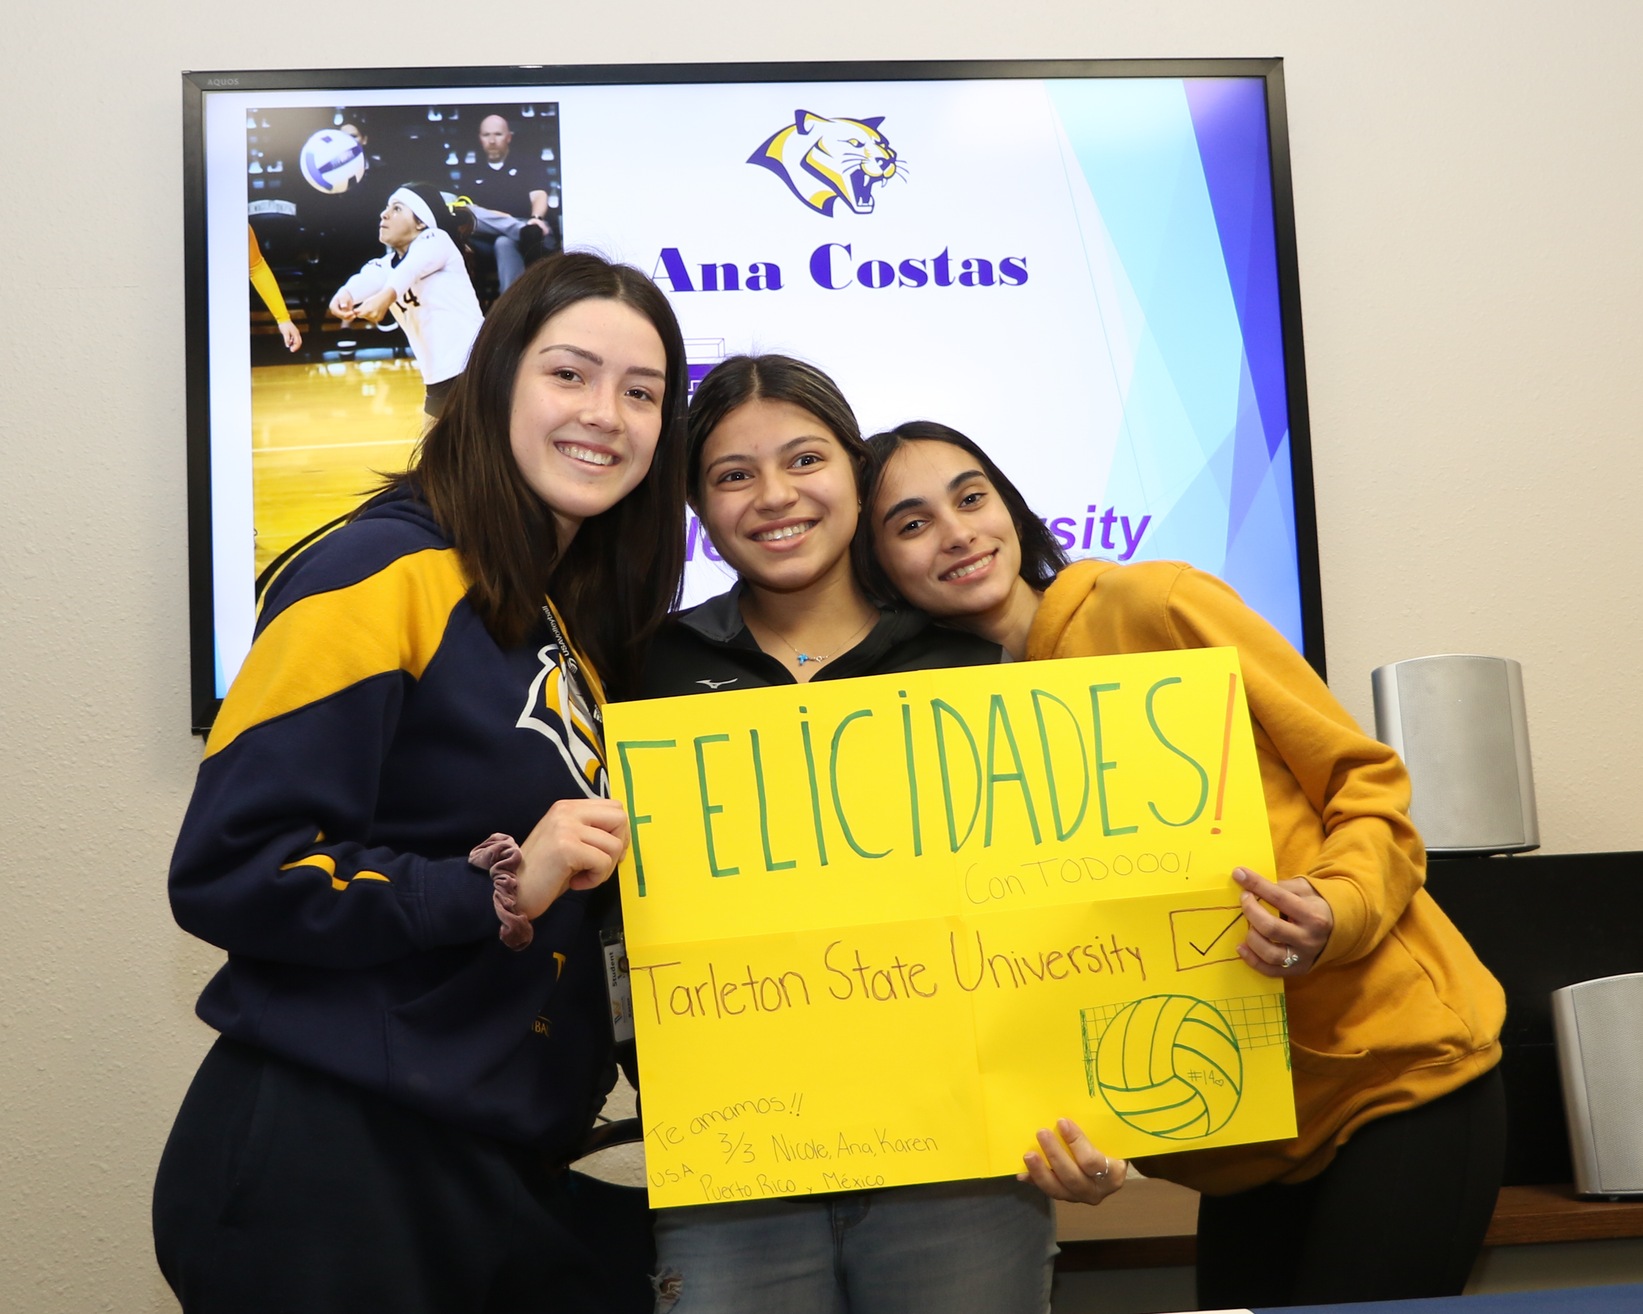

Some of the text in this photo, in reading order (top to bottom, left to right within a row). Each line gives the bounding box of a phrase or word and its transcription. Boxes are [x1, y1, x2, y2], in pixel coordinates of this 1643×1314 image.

[207, 78, 240, 87] AQUOS
[652, 243, 1029, 292] Ana Costas
[964, 850, 1192, 905] Con TODOOO!
[609, 951, 618, 987] Student
[630, 961, 811, 1025] Tarleton
[824, 940, 938, 1001] State
[949, 930, 1147, 992] University
[645, 1092, 804, 1151] Te amamos!!
[717, 1128, 939, 1165] 3/3 Nicole, Ana, Karen
[700, 1173, 752, 1202] Puerto
[756, 1173, 797, 1196] Rico
[822, 1172, 886, 1191] México
